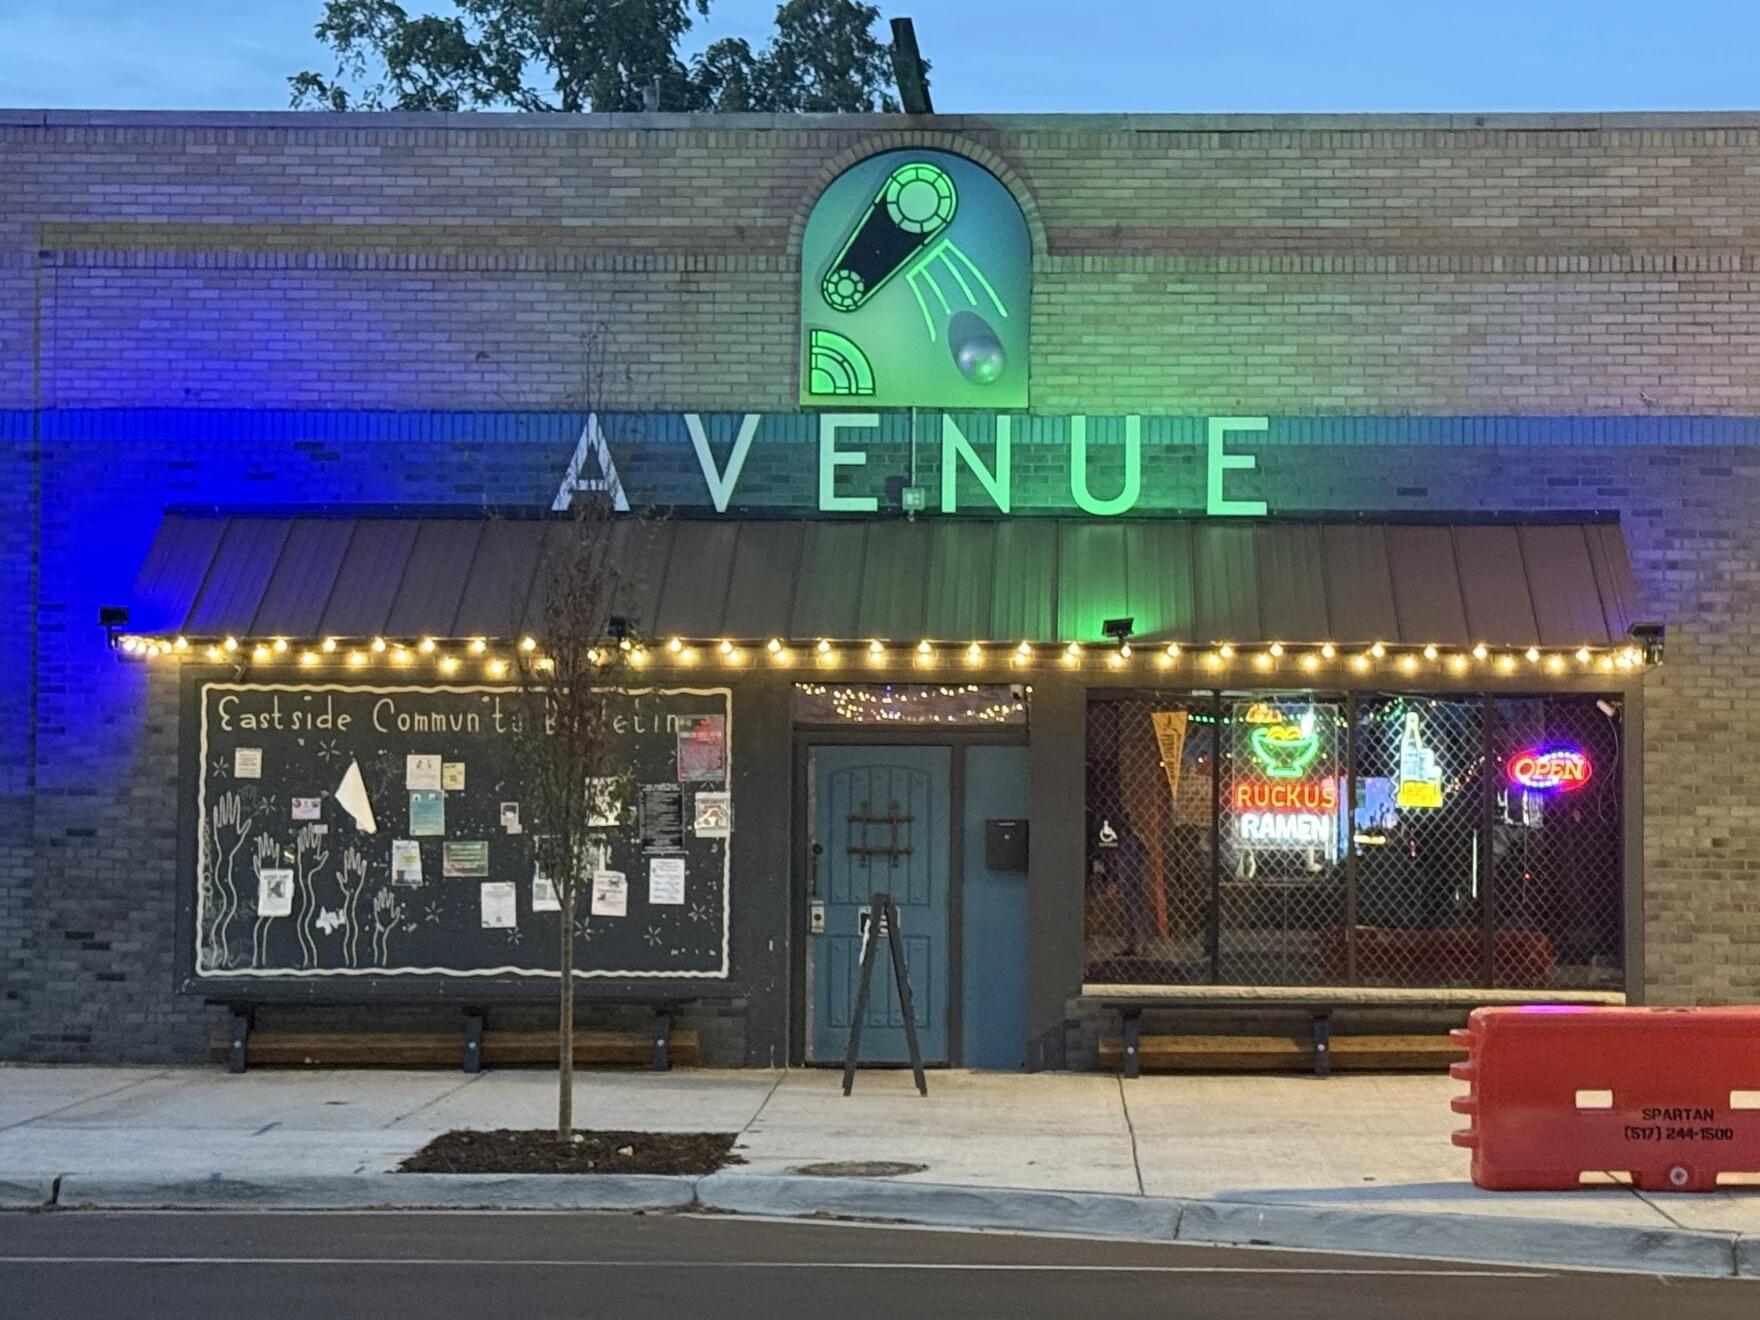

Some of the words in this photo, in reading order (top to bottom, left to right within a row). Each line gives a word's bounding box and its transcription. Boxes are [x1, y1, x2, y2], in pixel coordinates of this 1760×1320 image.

[551, 412, 1269, 516] AVENUE
[218, 694, 352, 732] Eastside
[373, 696, 523, 740] Communty
[544, 695, 679, 736] Bletin
[1514, 757, 1585, 781] OPEN
[1237, 783, 1336, 808] RUCKUS
[1240, 812, 1331, 840] RAMEN
[1642, 1108, 1715, 1122] SPARTAN
[1624, 1126, 1662, 1141] (517)
[1666, 1127, 1733, 1141] 244-1500
